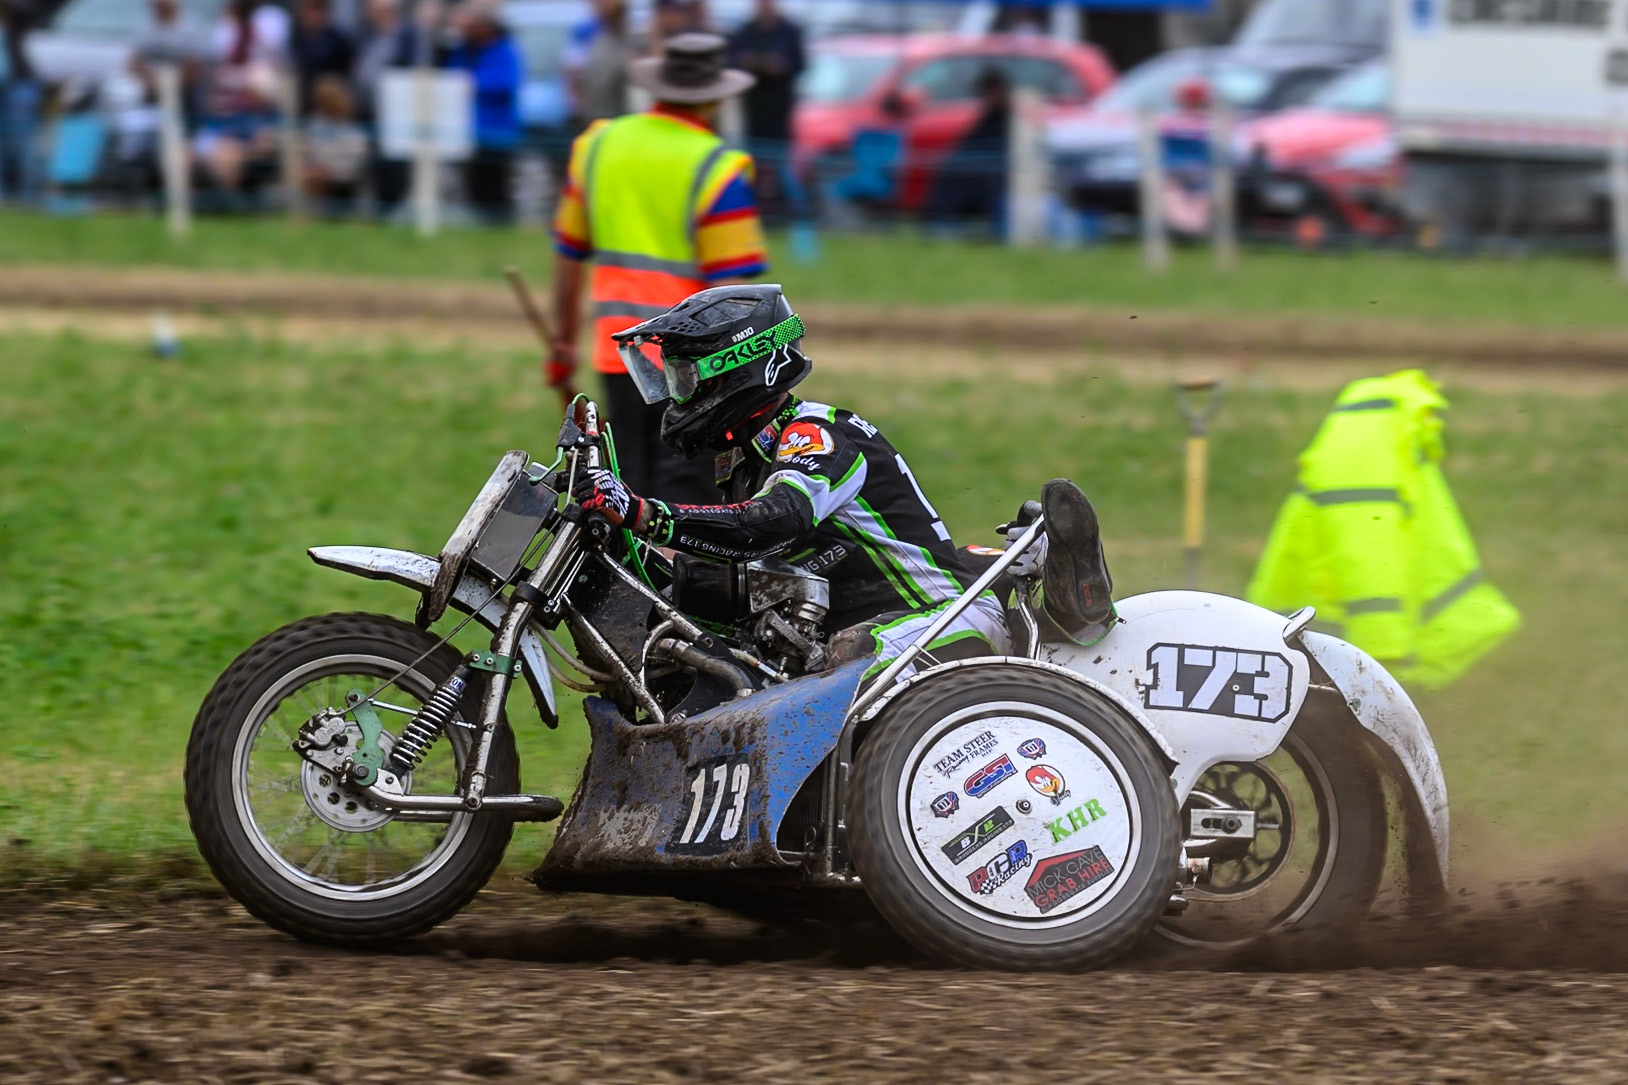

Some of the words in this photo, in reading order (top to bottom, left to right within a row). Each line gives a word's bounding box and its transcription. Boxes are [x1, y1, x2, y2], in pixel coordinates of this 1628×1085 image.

[710, 331, 776, 372] OAKLEY
[680, 535, 699, 548] 173
[818, 544, 847, 566] 173
[1146, 643, 1292, 722] 173
[934, 749, 964, 773] TEAM
[963, 730, 996, 754] STEER
[969, 739, 999, 759] FRAMES
[679, 763, 750, 844] 173
[1048, 799, 1107, 844] KHR
[967, 840, 1028, 893] PCR
[996, 854, 1033, 887] Racing
[1027, 867, 1066, 898] MICK
[1066, 848, 1104, 874] CAVE
[1035, 877, 1077, 907] GRAB
[1077, 858, 1110, 882] HIRE
